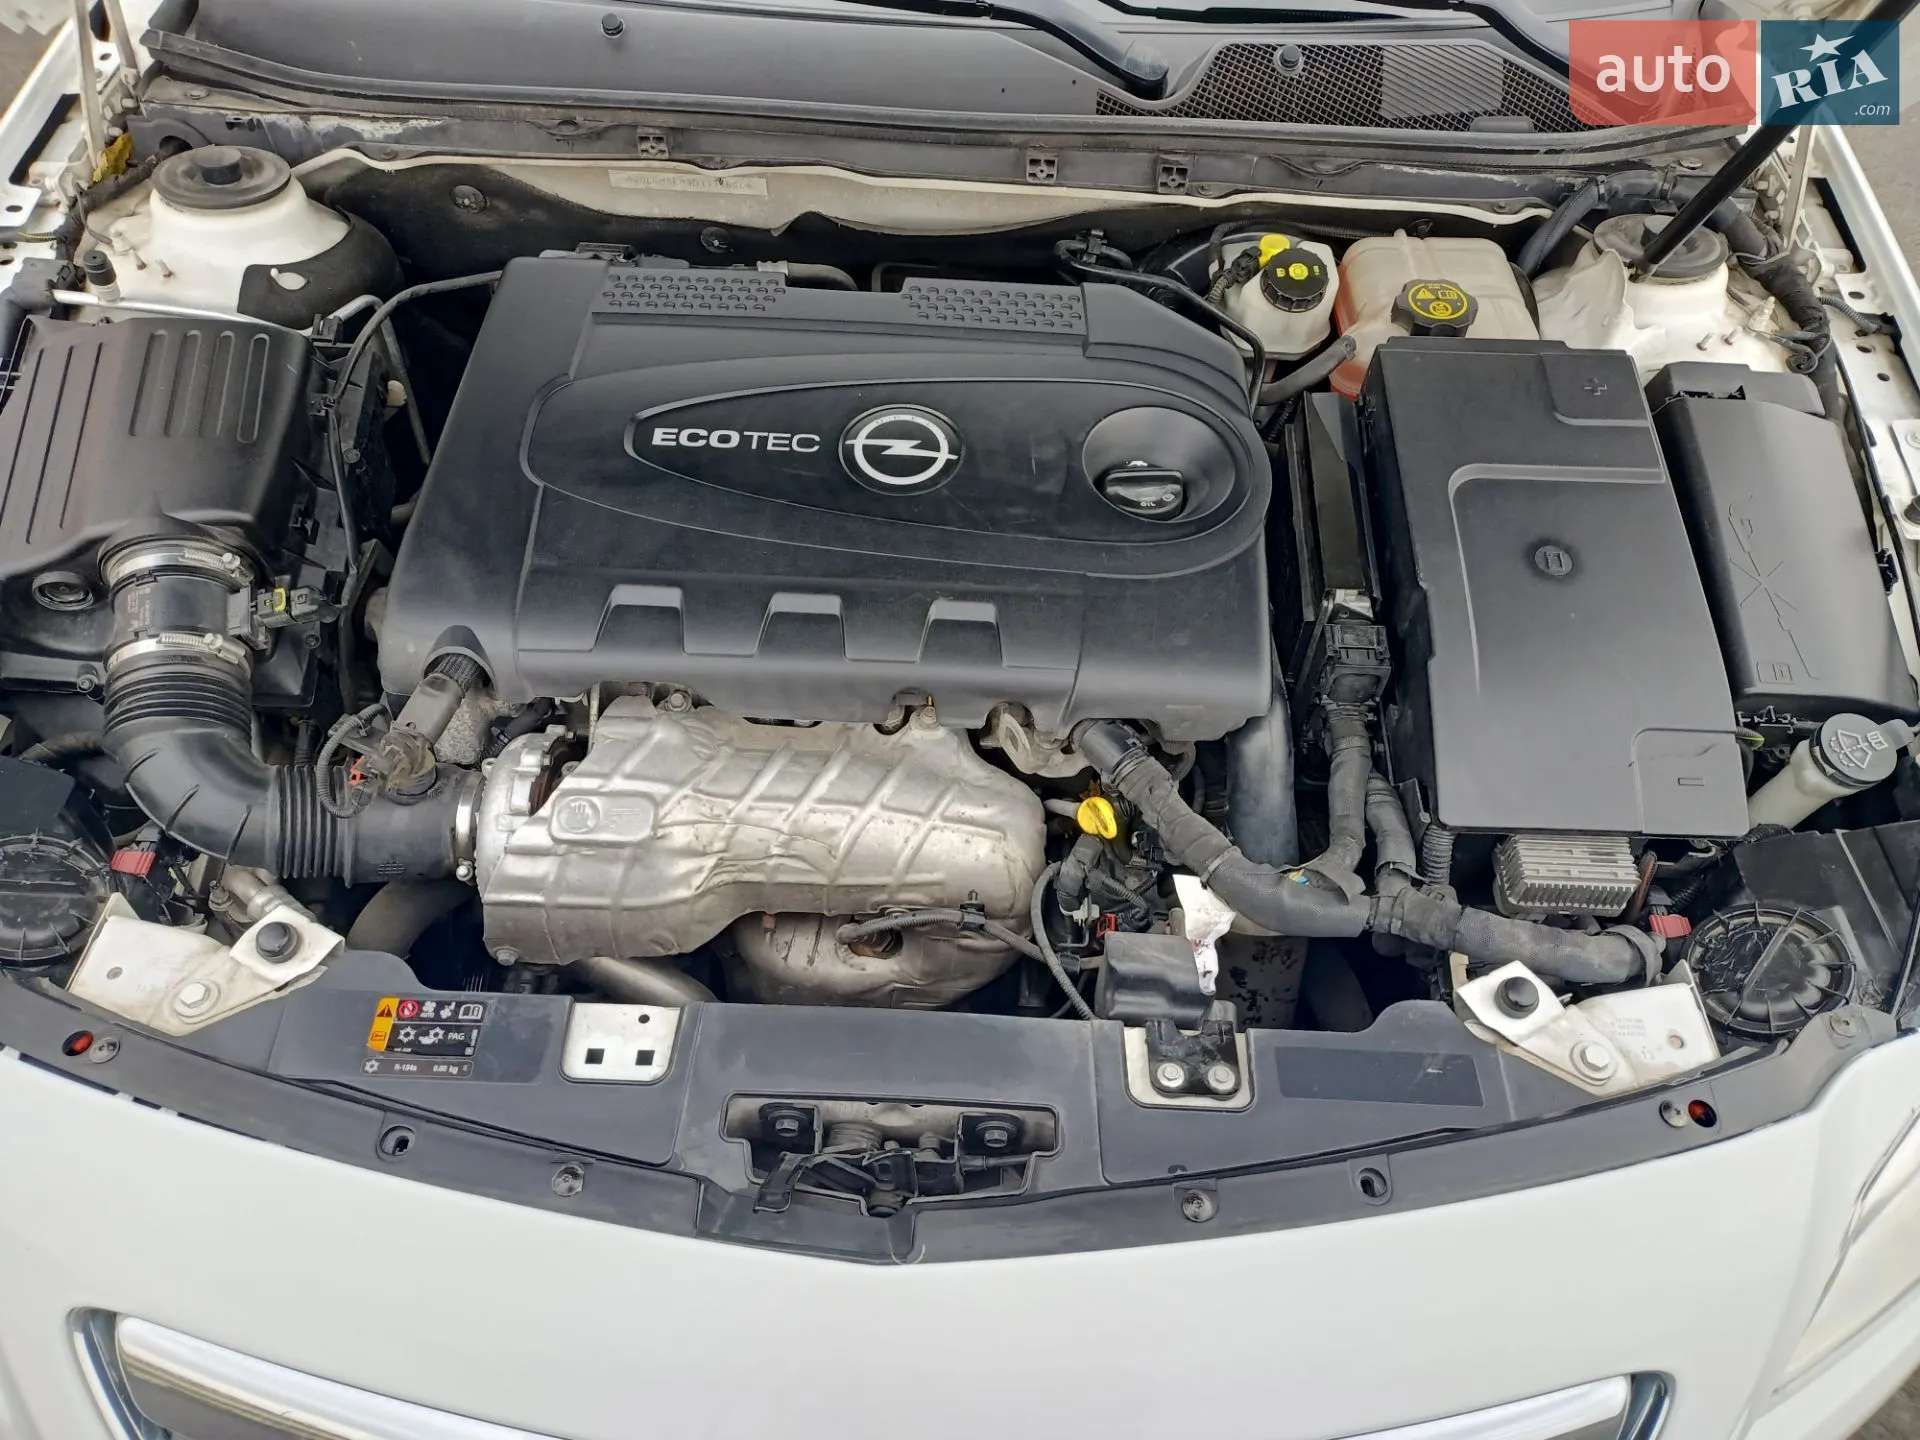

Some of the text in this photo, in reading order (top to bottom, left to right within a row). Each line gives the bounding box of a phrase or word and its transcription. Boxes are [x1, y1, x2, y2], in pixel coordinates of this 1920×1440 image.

[651, 427, 821, 452] ECOTEC
[447, 1032, 465, 1040] PAG
[448, 1064, 459, 1075] kg
